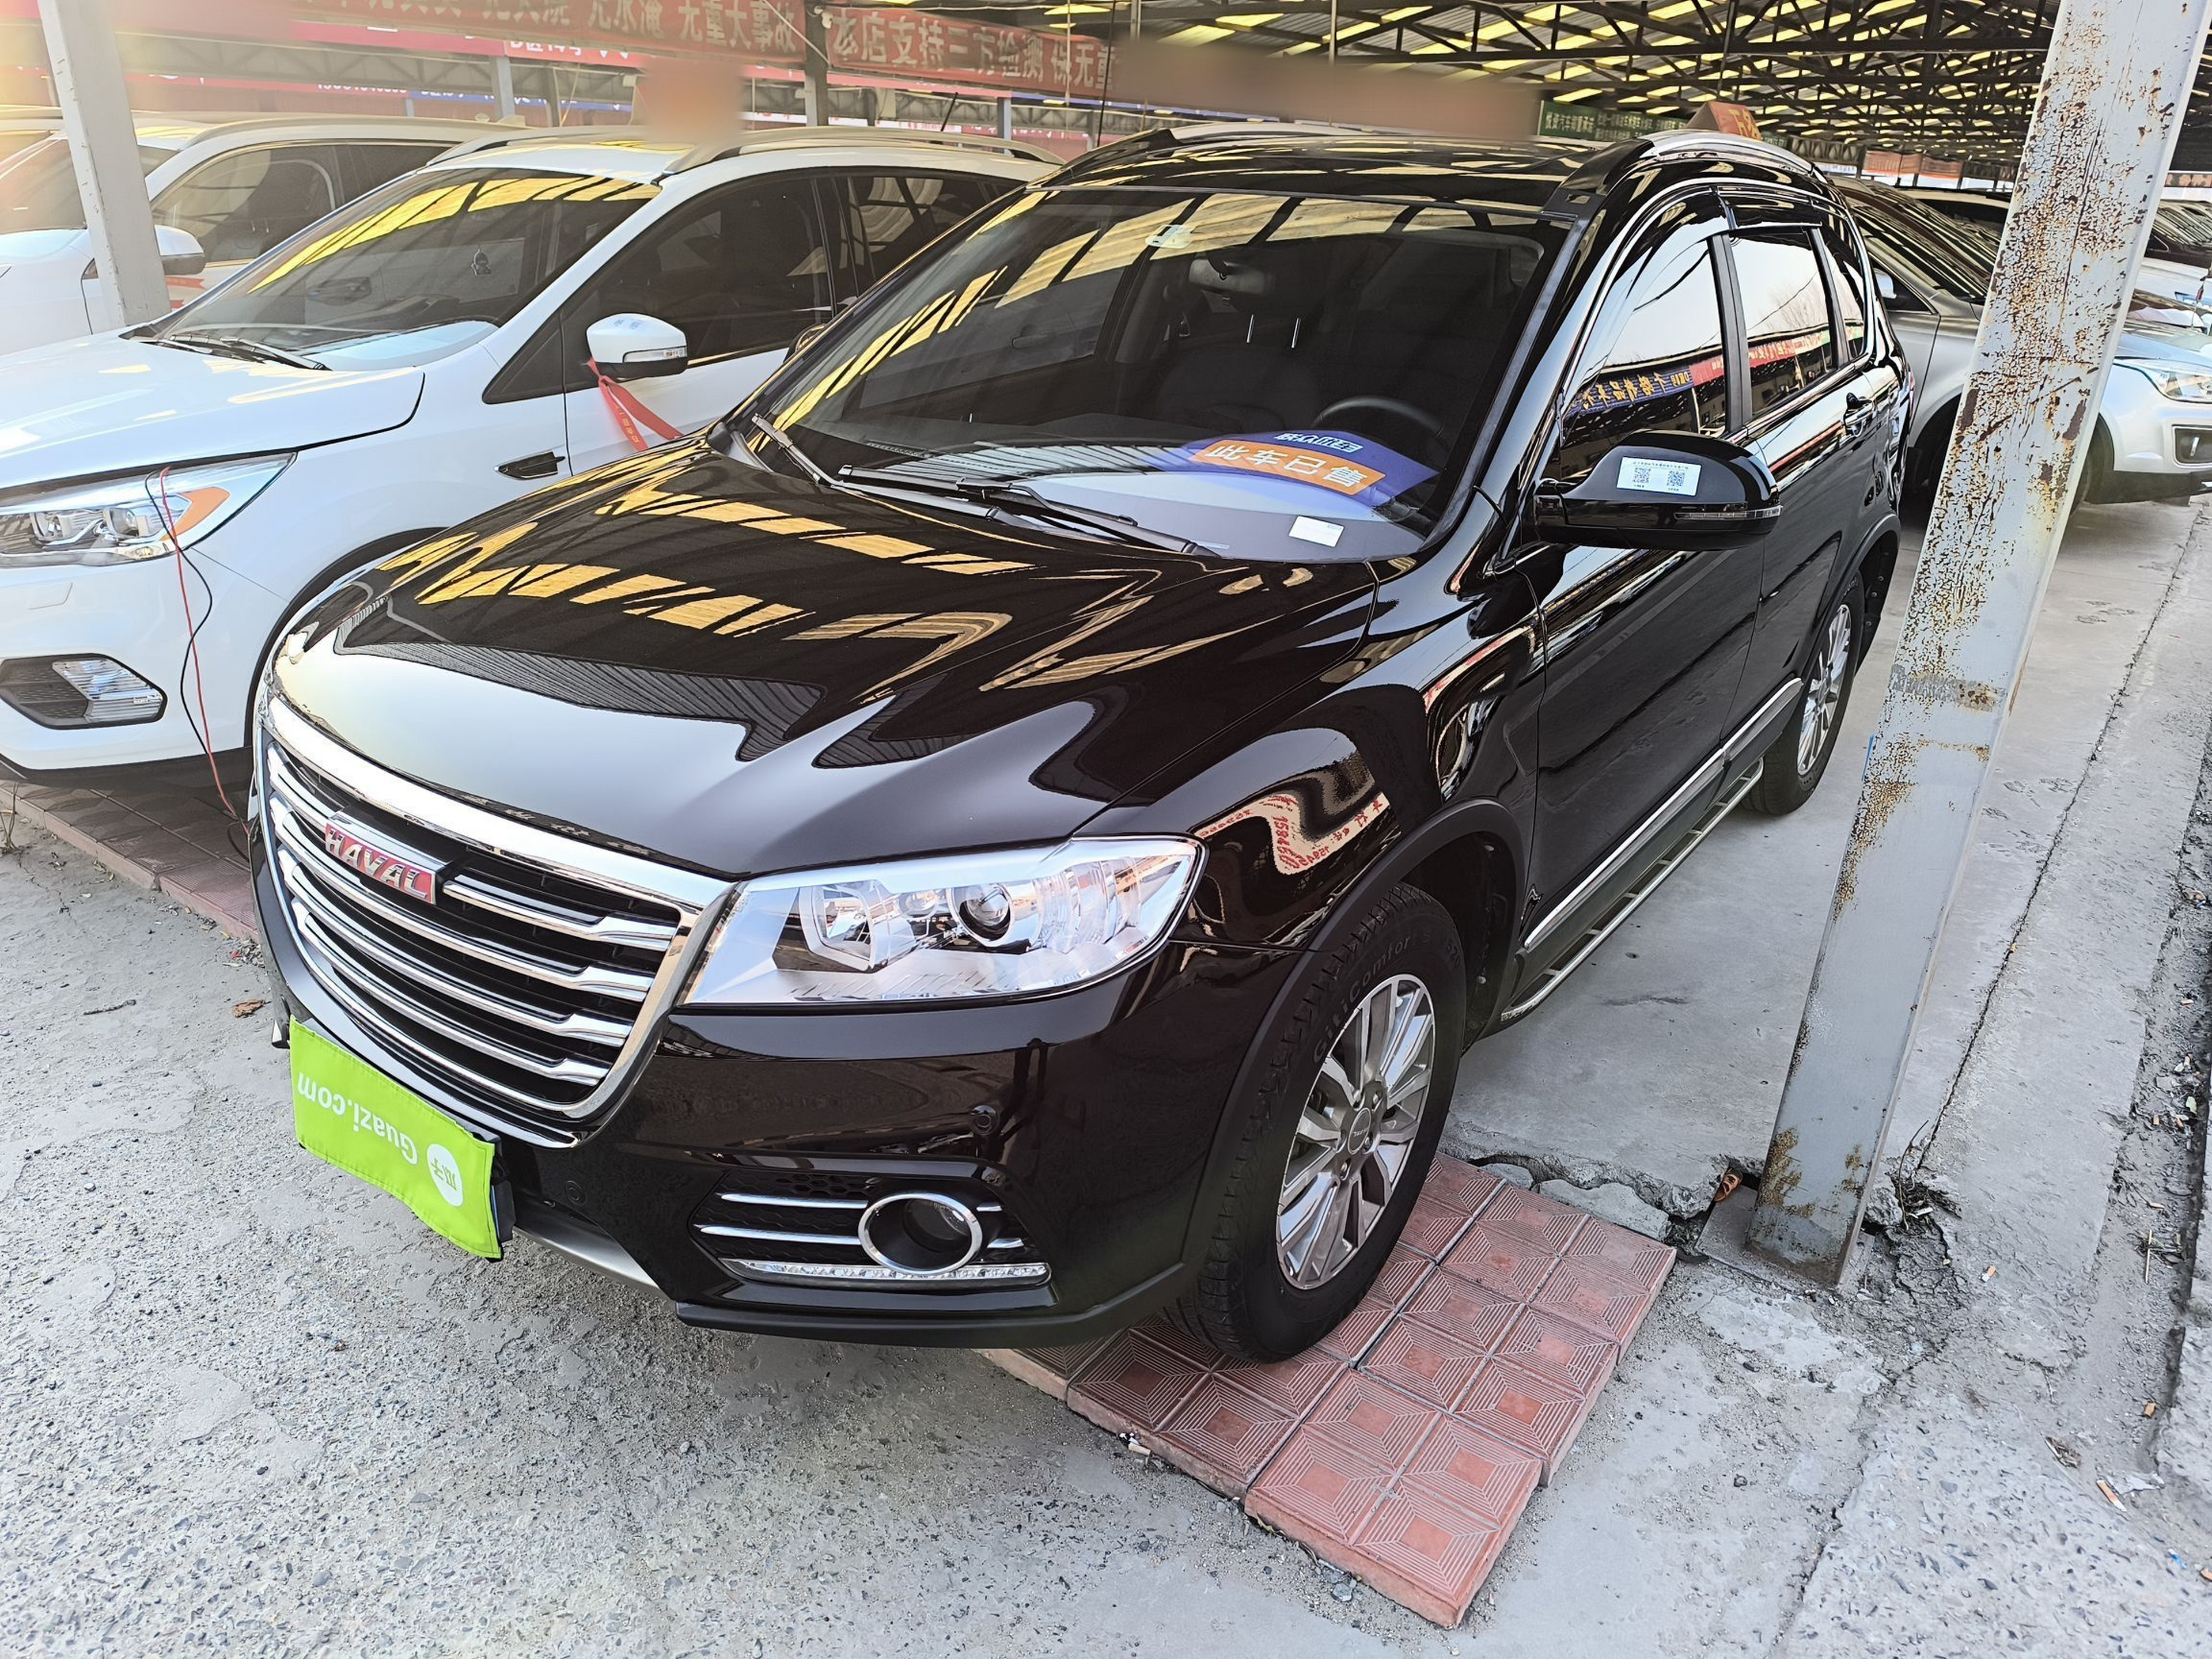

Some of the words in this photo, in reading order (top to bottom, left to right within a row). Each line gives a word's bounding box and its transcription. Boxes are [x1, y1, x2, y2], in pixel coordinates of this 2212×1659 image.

[1205, 444, 1368, 488] 此车已售
[325, 828, 428, 899] HAVAL
[297, 1072, 419, 1165] Guazi.com
[430, 1158, 459, 1191] 瓜子
